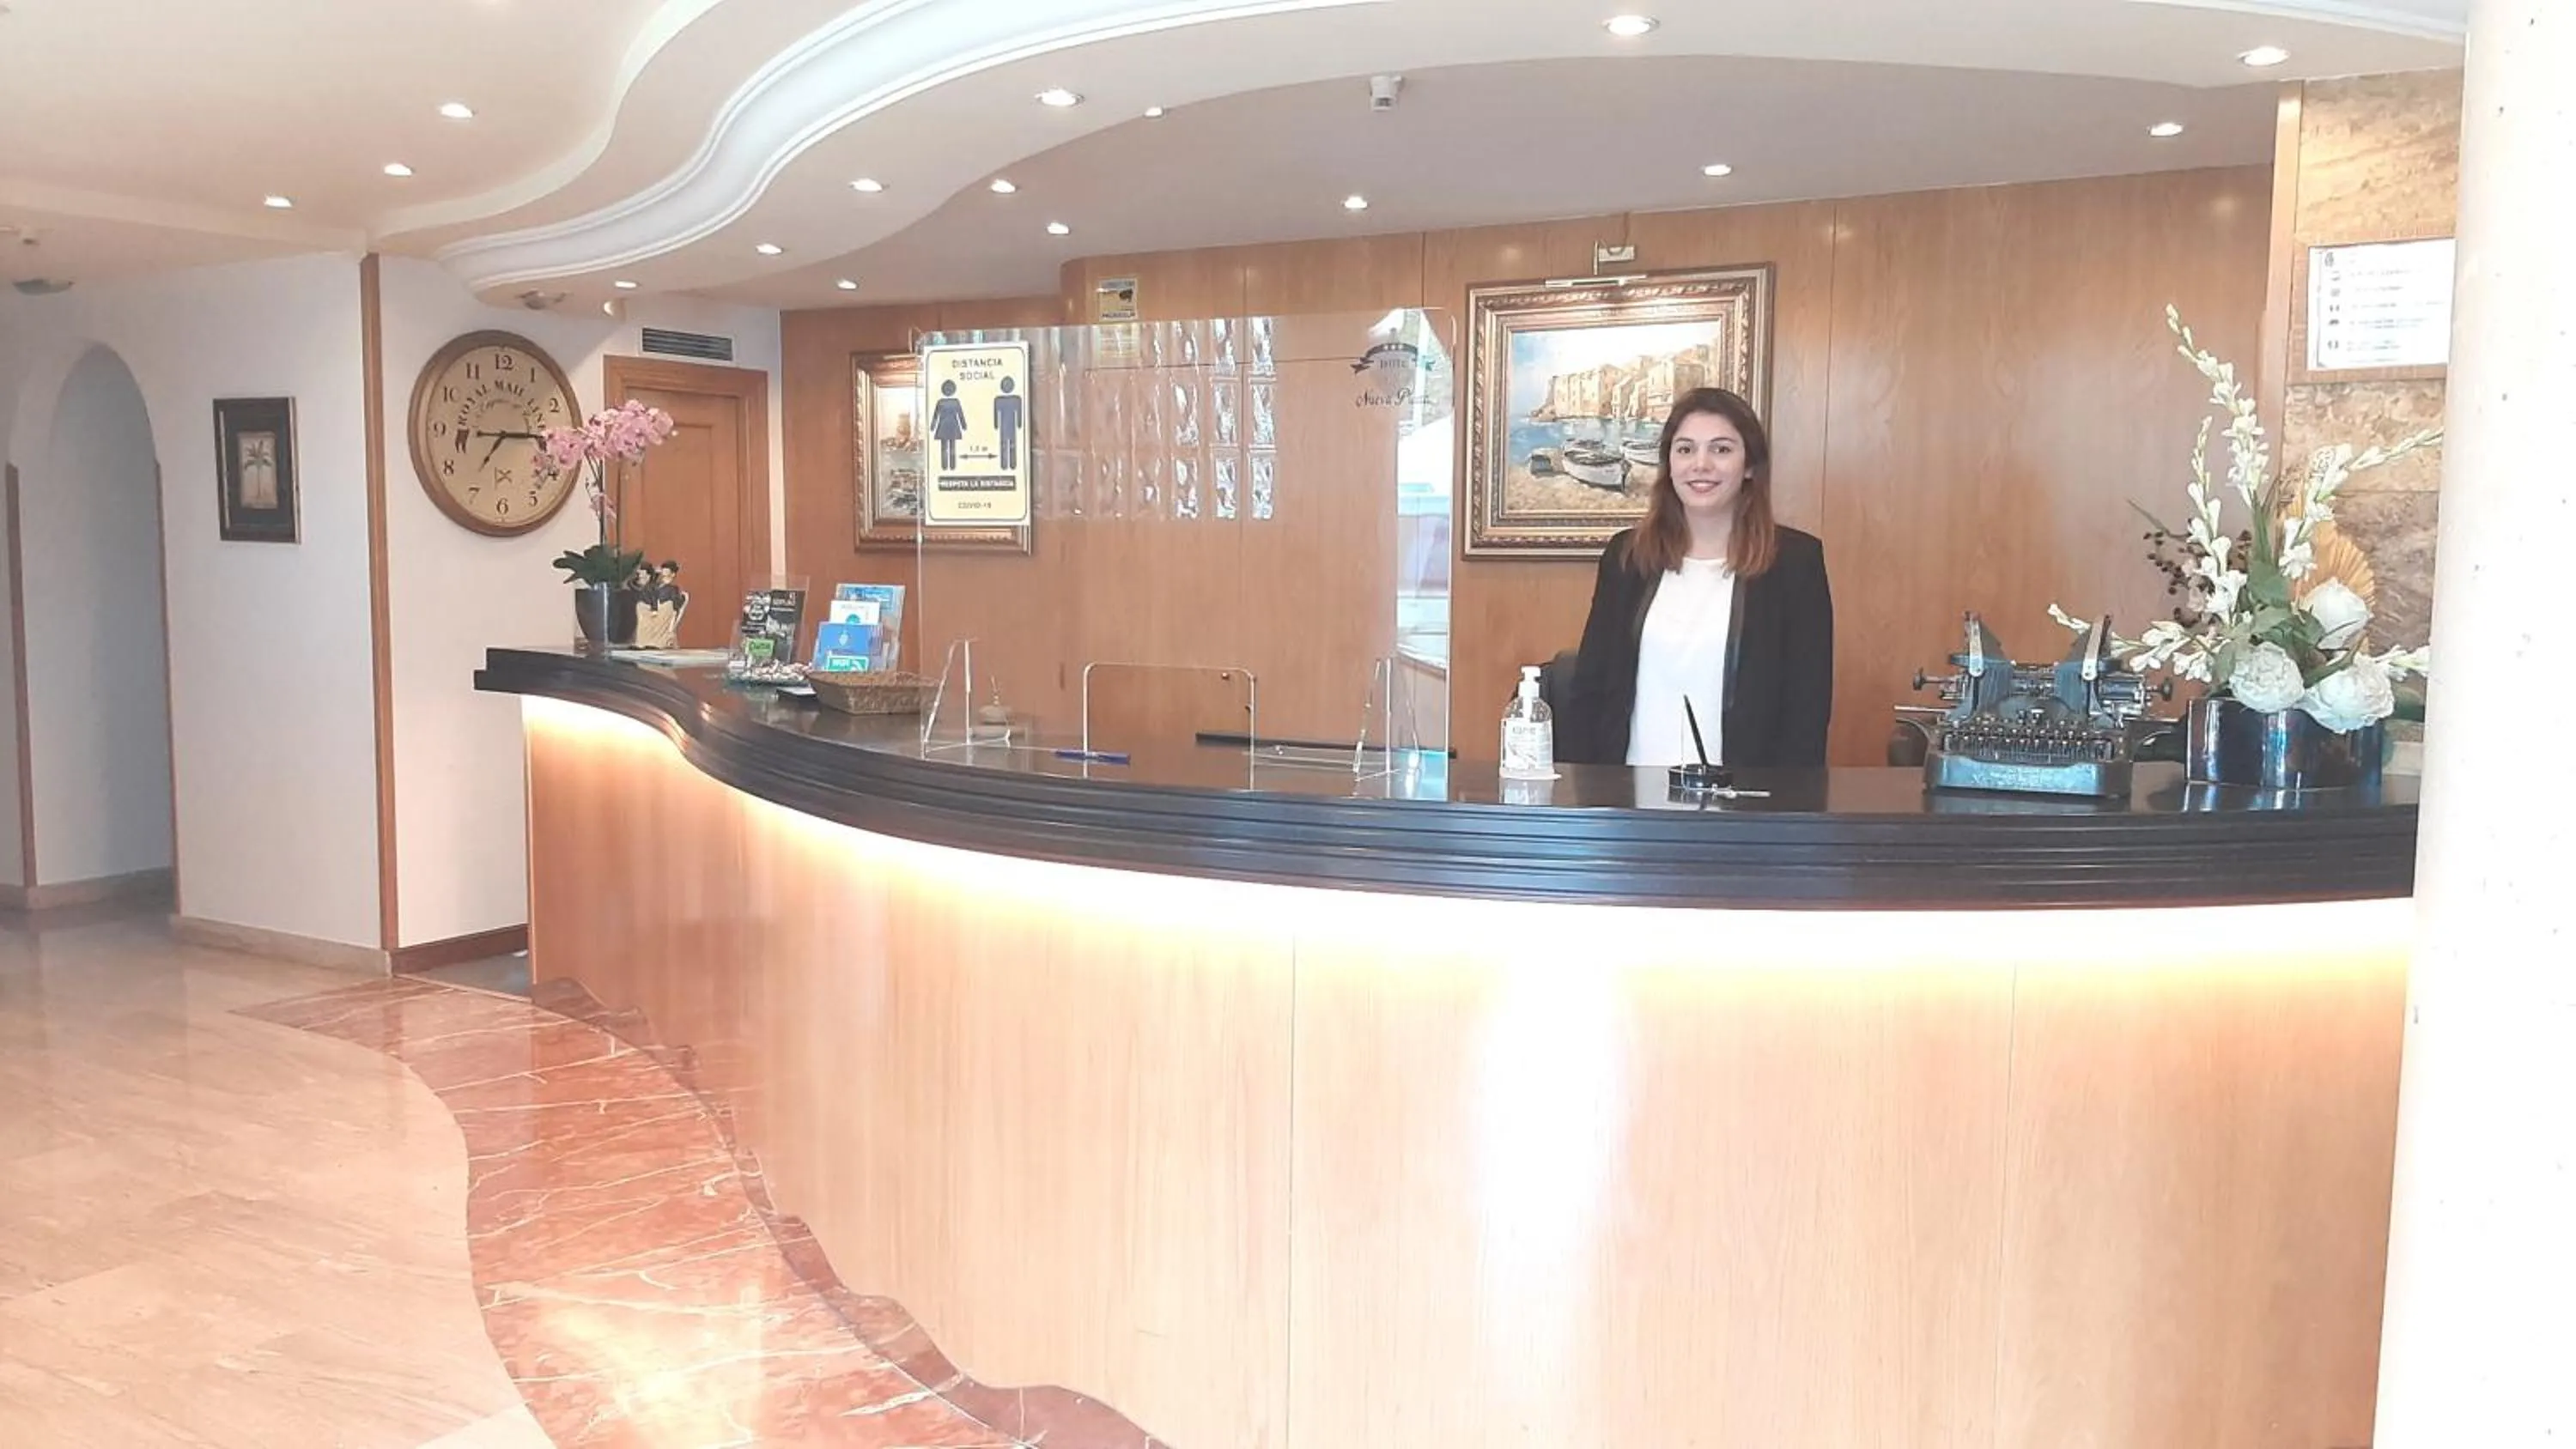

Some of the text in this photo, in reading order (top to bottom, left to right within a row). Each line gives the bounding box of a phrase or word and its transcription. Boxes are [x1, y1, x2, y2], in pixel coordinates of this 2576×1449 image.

[495, 354, 513, 370] 12
[951, 357, 1004, 368] DISTANCIA
[466, 363, 481, 380] 11
[530, 367, 537, 384] 1
[959, 371, 995, 380] SOCIAL
[443, 385, 460, 403] 10
[458, 384, 491, 427] ROYAL
[495, 379, 526, 397] MAIL
[549, 397, 561, 414] 2
[434, 421, 447, 438] 9
[443, 459, 455, 476] 8
[468, 487, 481, 505] 7
[528, 490, 538, 506] 5
[496, 498, 510, 515] 6
